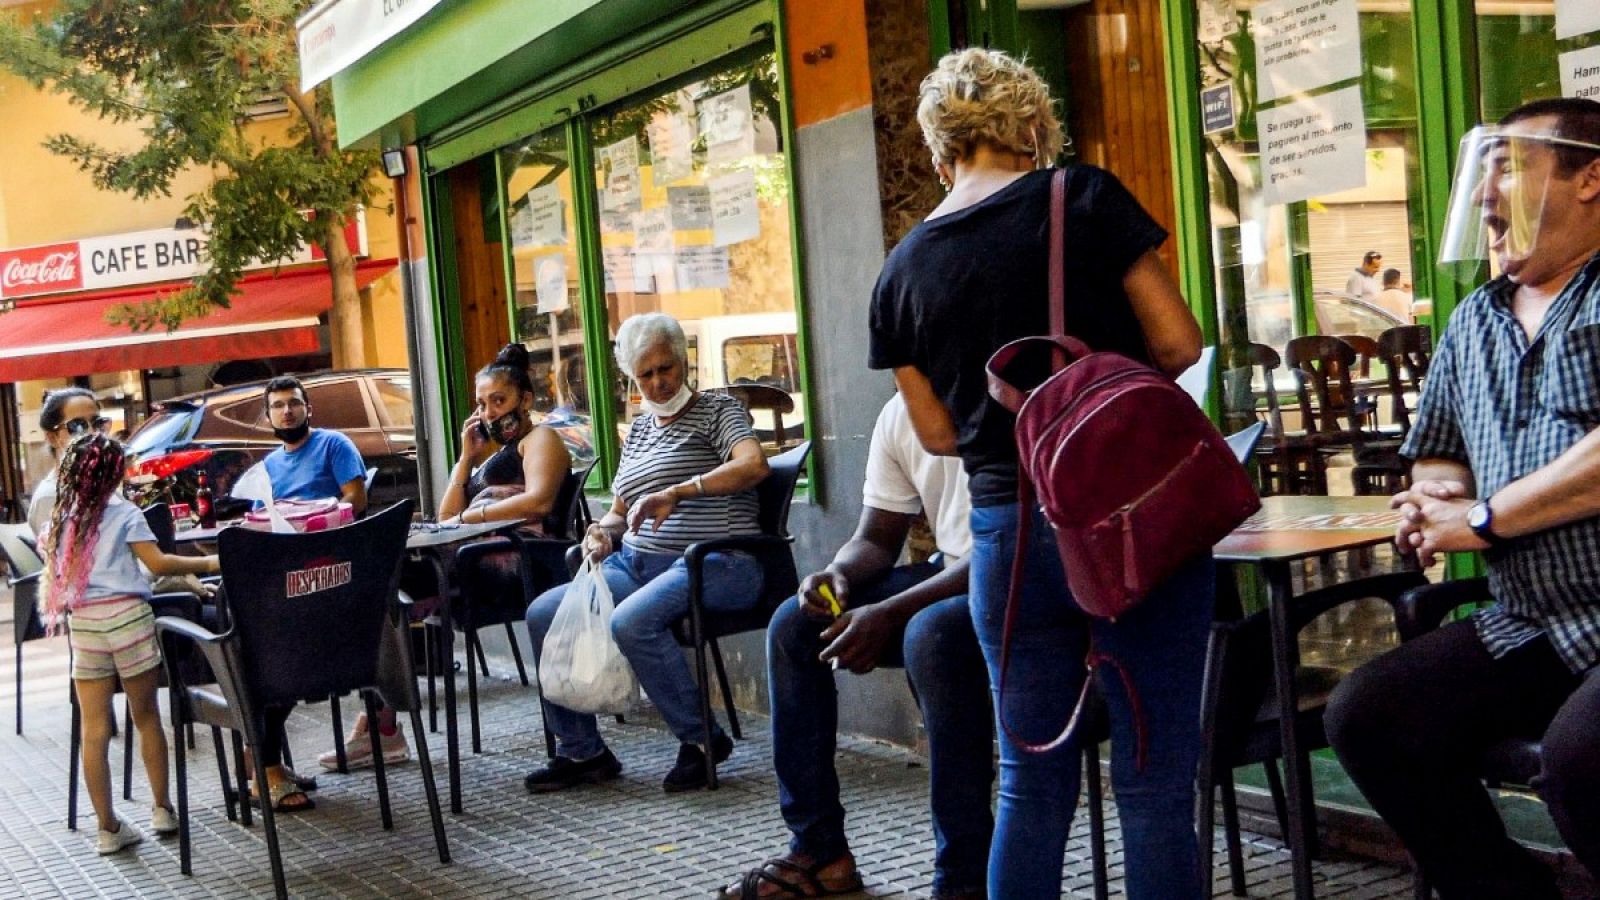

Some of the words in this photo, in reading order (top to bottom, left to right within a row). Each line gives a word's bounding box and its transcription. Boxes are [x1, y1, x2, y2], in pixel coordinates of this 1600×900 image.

[1267, 123, 1279, 133] Se
[1280, 117, 1304, 129] ruega
[1268, 136, 1299, 152] paguen
[1301, 131, 1310, 141] al
[1269, 156, 1280, 166] de
[1282, 152, 1296, 163] ser
[3, 252, 78, 288] Coca-Cola
[91, 244, 149, 276] CAFE
[155, 238, 201, 268] BAR
[287, 561, 352, 598] DESPERADOS
